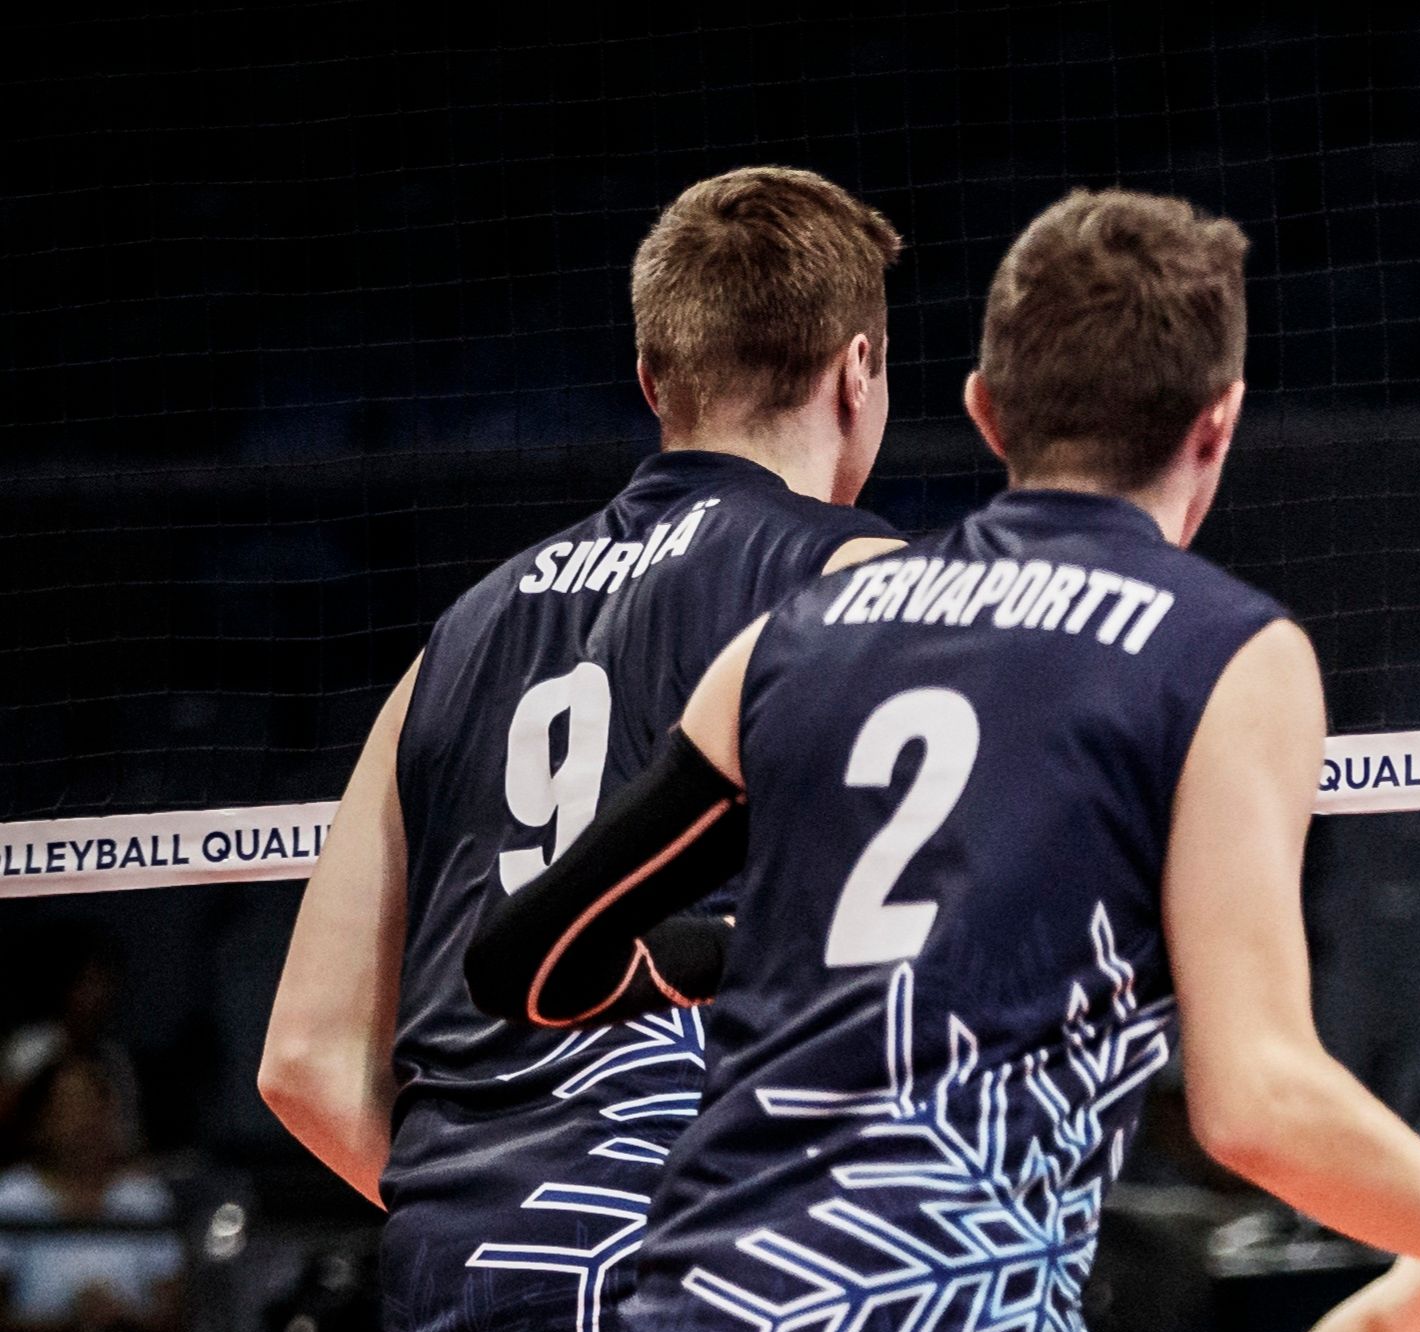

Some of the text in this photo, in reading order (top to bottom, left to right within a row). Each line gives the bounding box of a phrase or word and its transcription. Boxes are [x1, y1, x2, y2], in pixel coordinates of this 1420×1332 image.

[823, 556, 1175, 655] TERVAPORTTI
[0, 824, 333, 877] LLEYBALL QUALI
[499, 660, 613, 896] 9
[823, 686, 980, 969] 2
